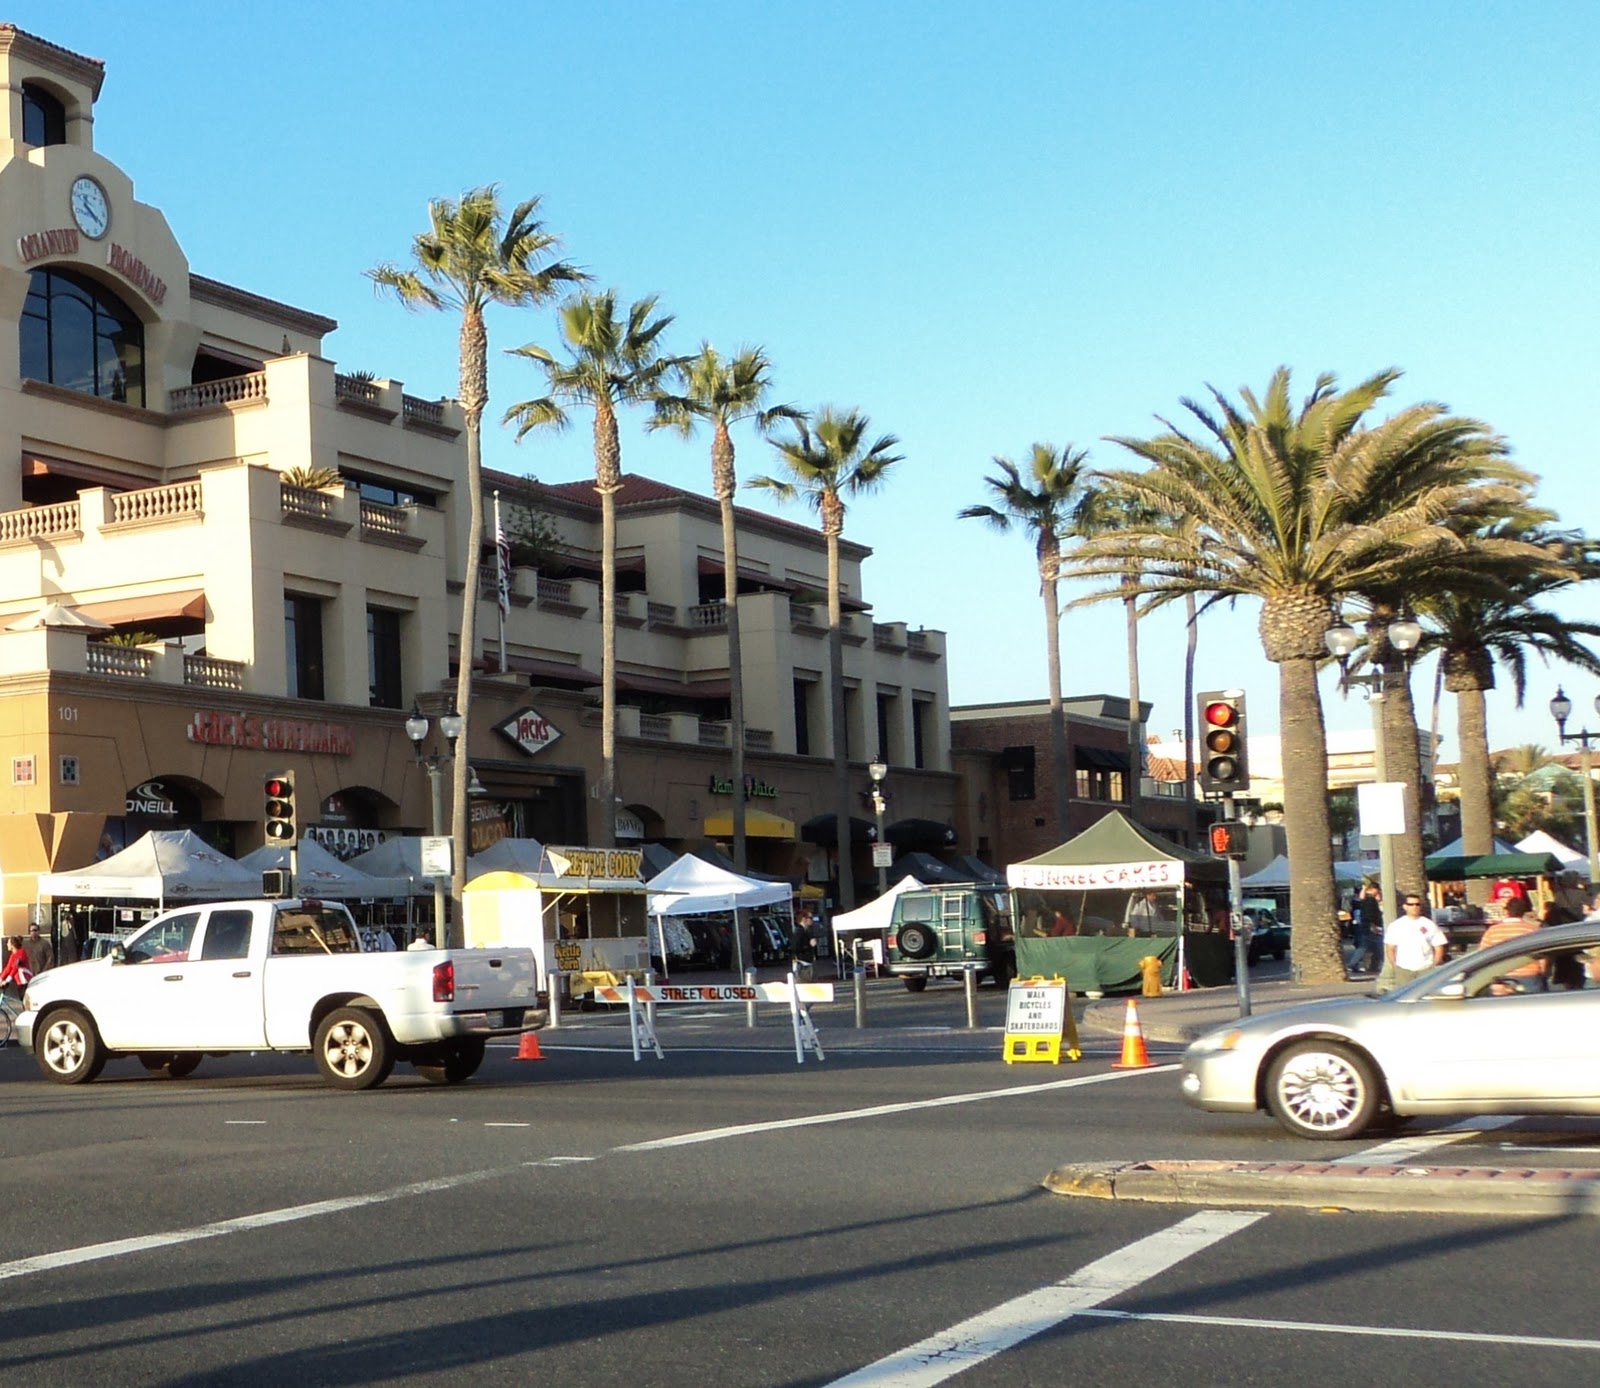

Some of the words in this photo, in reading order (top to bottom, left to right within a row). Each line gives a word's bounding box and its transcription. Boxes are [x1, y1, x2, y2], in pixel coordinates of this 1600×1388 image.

[58, 707, 78, 721] 101
[564, 849, 607, 877] KETTLE
[608, 851, 640, 878] CORN
[1022, 869, 1097, 887] FUNNEL
[1103, 864, 1169, 884] CAKES
[555, 943, 582, 960] Kettle
[558, 958, 580, 972] Corn
[660, 987, 704, 1000] STREET
[708, 987, 756, 1000] CLOSED
[1027, 991, 1045, 999] WALK
[1019, 1001, 1051, 1010] BICYCLES
[1028, 1012, 1042, 1020] AND
[1010, 1022, 1058, 1031] SKATEBOARDS
